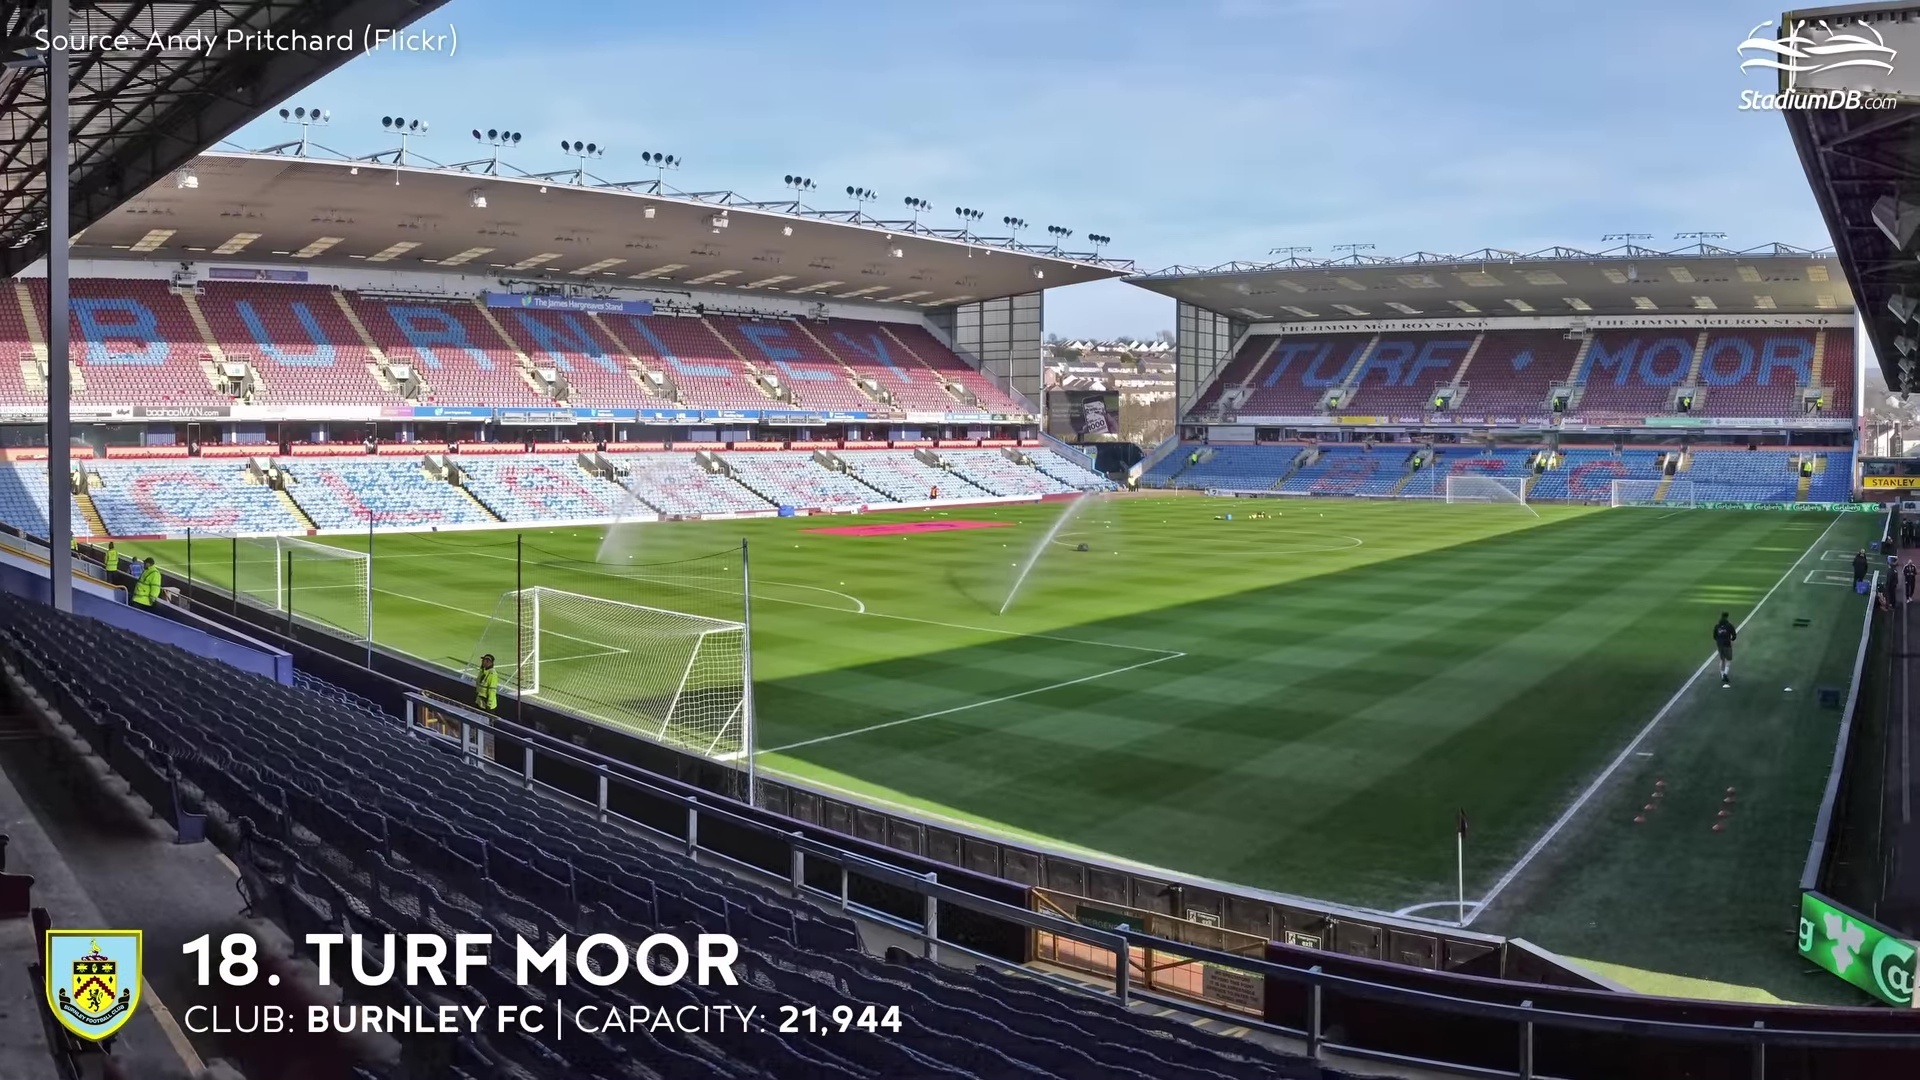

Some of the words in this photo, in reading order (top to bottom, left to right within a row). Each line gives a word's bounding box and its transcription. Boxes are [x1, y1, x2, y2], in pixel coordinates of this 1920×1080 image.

[534, 298, 547, 306] The
[547, 298, 568, 308] James
[569, 300, 605, 311] Hargreaves
[605, 301, 623, 311] Stand
[1263, 340, 1472, 388] TURF
[1578, 336, 1815, 388] MOOR
[146, 407, 219, 417] boohooMAN.com
[1872, 478, 1915, 487] STANLEY
[1754, 502, 1782, 510] Carlsberg
[1793, 502, 1821, 511] Carlsberg
[1832, 502, 1861, 512] Carlsberg
[1302, 940, 1313, 948] exit
